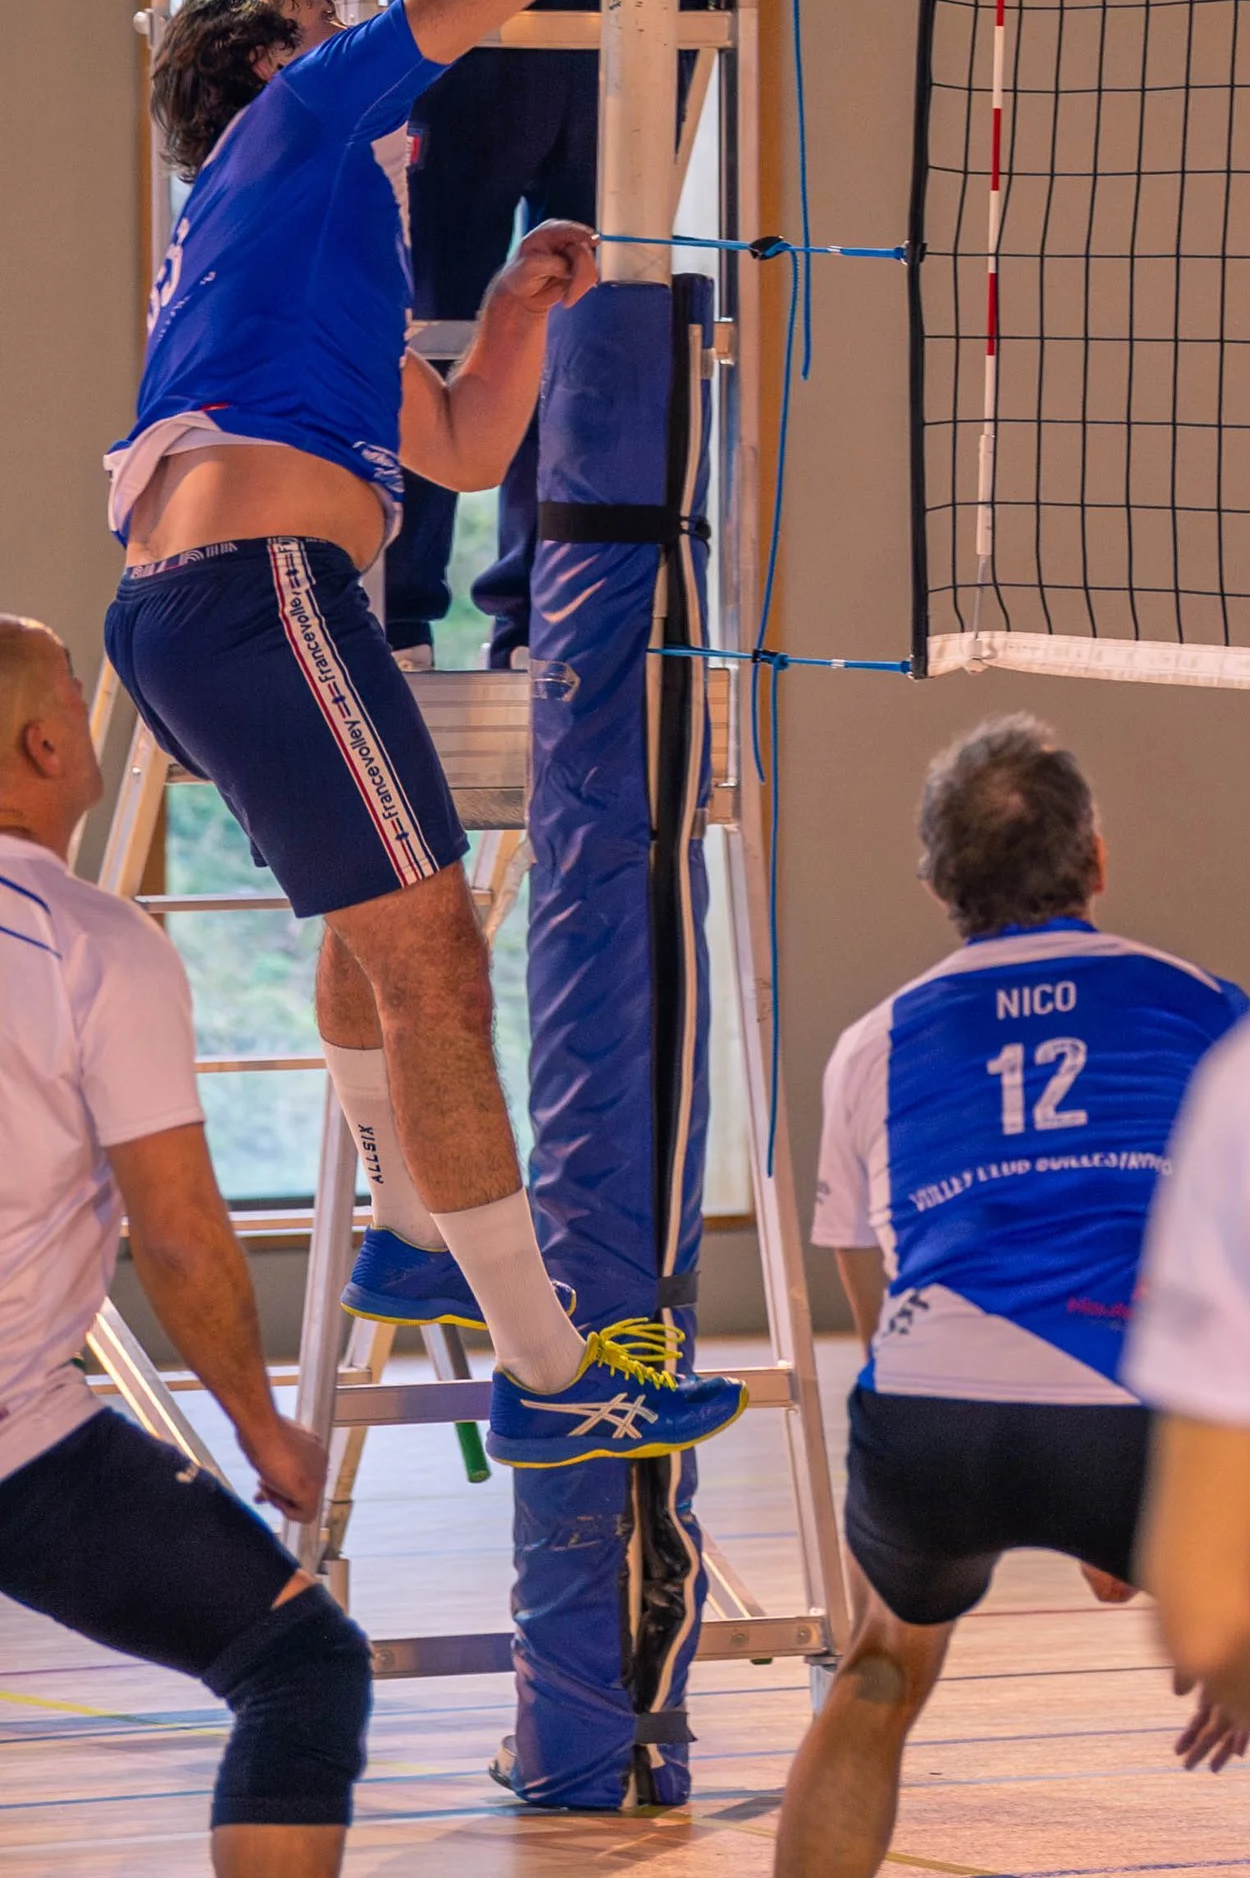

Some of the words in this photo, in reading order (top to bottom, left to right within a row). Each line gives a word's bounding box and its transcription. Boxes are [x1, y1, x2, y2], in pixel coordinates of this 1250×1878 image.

[996, 981, 1077, 1020] NICO
[987, 1036, 1088, 1135] 12
[358, 1123, 384, 1184] ALLSIX
